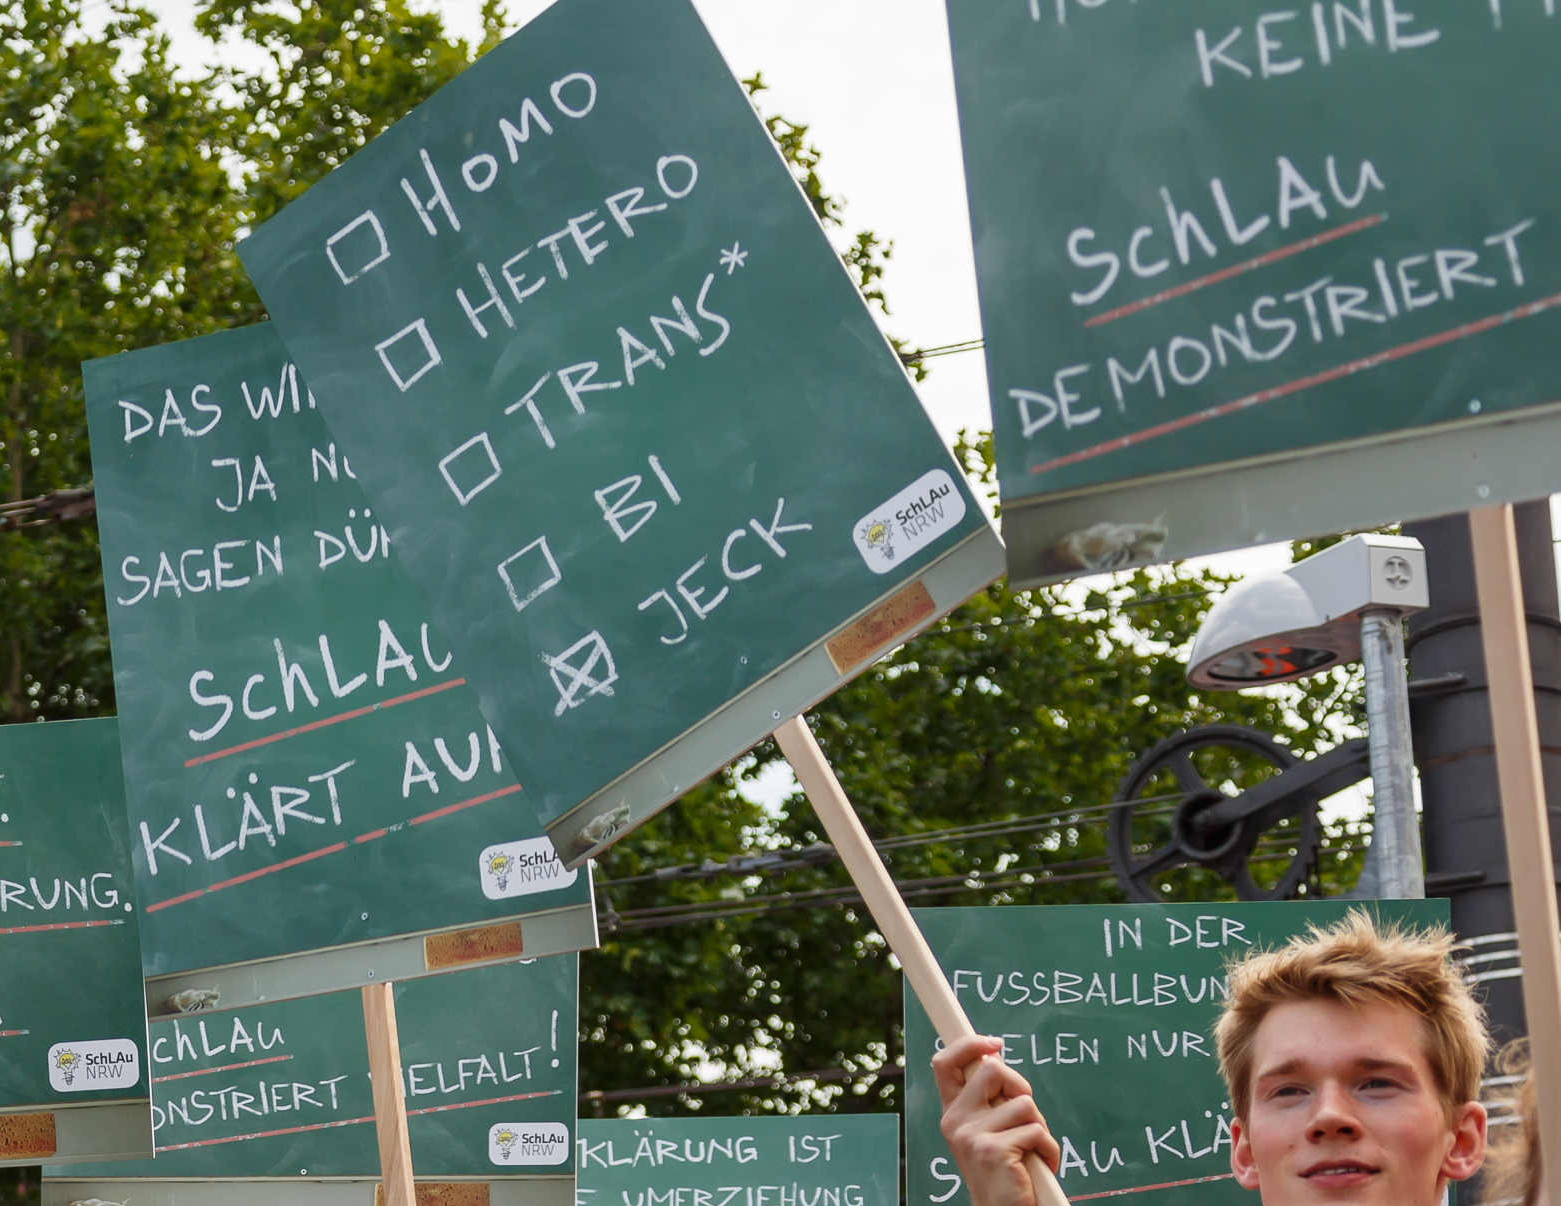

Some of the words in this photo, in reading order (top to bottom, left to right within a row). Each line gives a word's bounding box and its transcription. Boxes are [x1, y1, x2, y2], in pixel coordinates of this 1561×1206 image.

[1194, 0, 1440, 87] KEINE
[457, 154, 699, 338] HETERO
[1009, 219, 1535, 438] DEMONSTRIERT
[117, 383, 222, 444] DAS
[240, 362, 316, 420] WI
[211, 454, 277, 513] JA
[593, 454, 682, 543] BI
[895, 483, 951, 526] SchLAu
[902, 501, 944, 541] NRW
[116, 534, 284, 606] SAGEN
[638, 497, 813, 645] JECK
[139, 754, 355, 879] KLÄRT
[519, 862, 560, 883] NRW
[1103, 917, 1143, 958] IN
[1166, 915, 1253, 949] DER
[85, 1051, 134, 1067] SchLAu
[1127, 1029, 1211, 1059] NUR
[85, 1066, 123, 1080] NRW
[521, 1132, 565, 1145] SchLAu
[521, 1144, 555, 1157] NRW
[576, 1136, 758, 1169] KLÄRUNG
[788, 1134, 842, 1163] IST
[929, 1136, 1125, 1203] SAu
